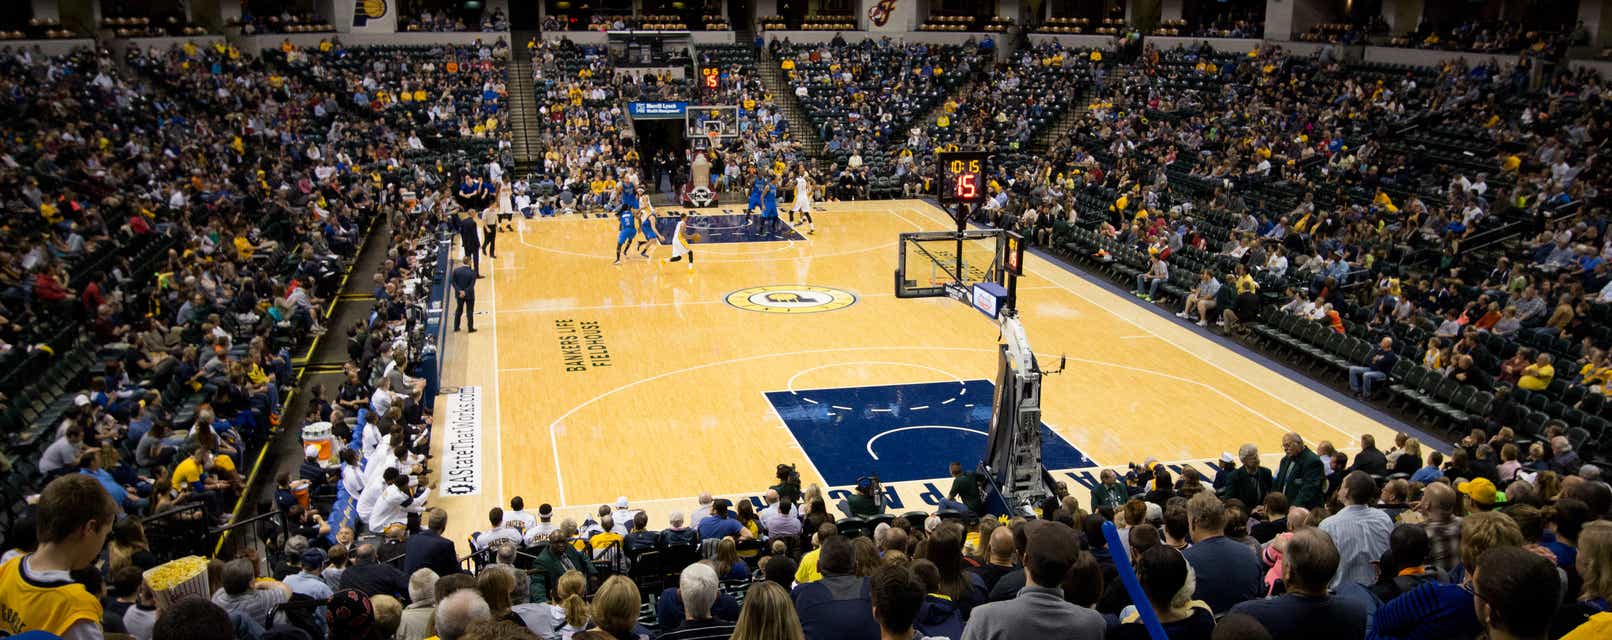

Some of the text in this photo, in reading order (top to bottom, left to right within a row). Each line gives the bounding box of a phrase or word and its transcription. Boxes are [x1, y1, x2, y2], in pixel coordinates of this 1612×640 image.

[706, 75, 717, 87] 15
[951, 160, 979, 174] 10:15
[958, 174, 975, 198] 15
[556, 318, 587, 372] BANKERS LIFE
[580, 320, 612, 367] FIELDHOUSE
